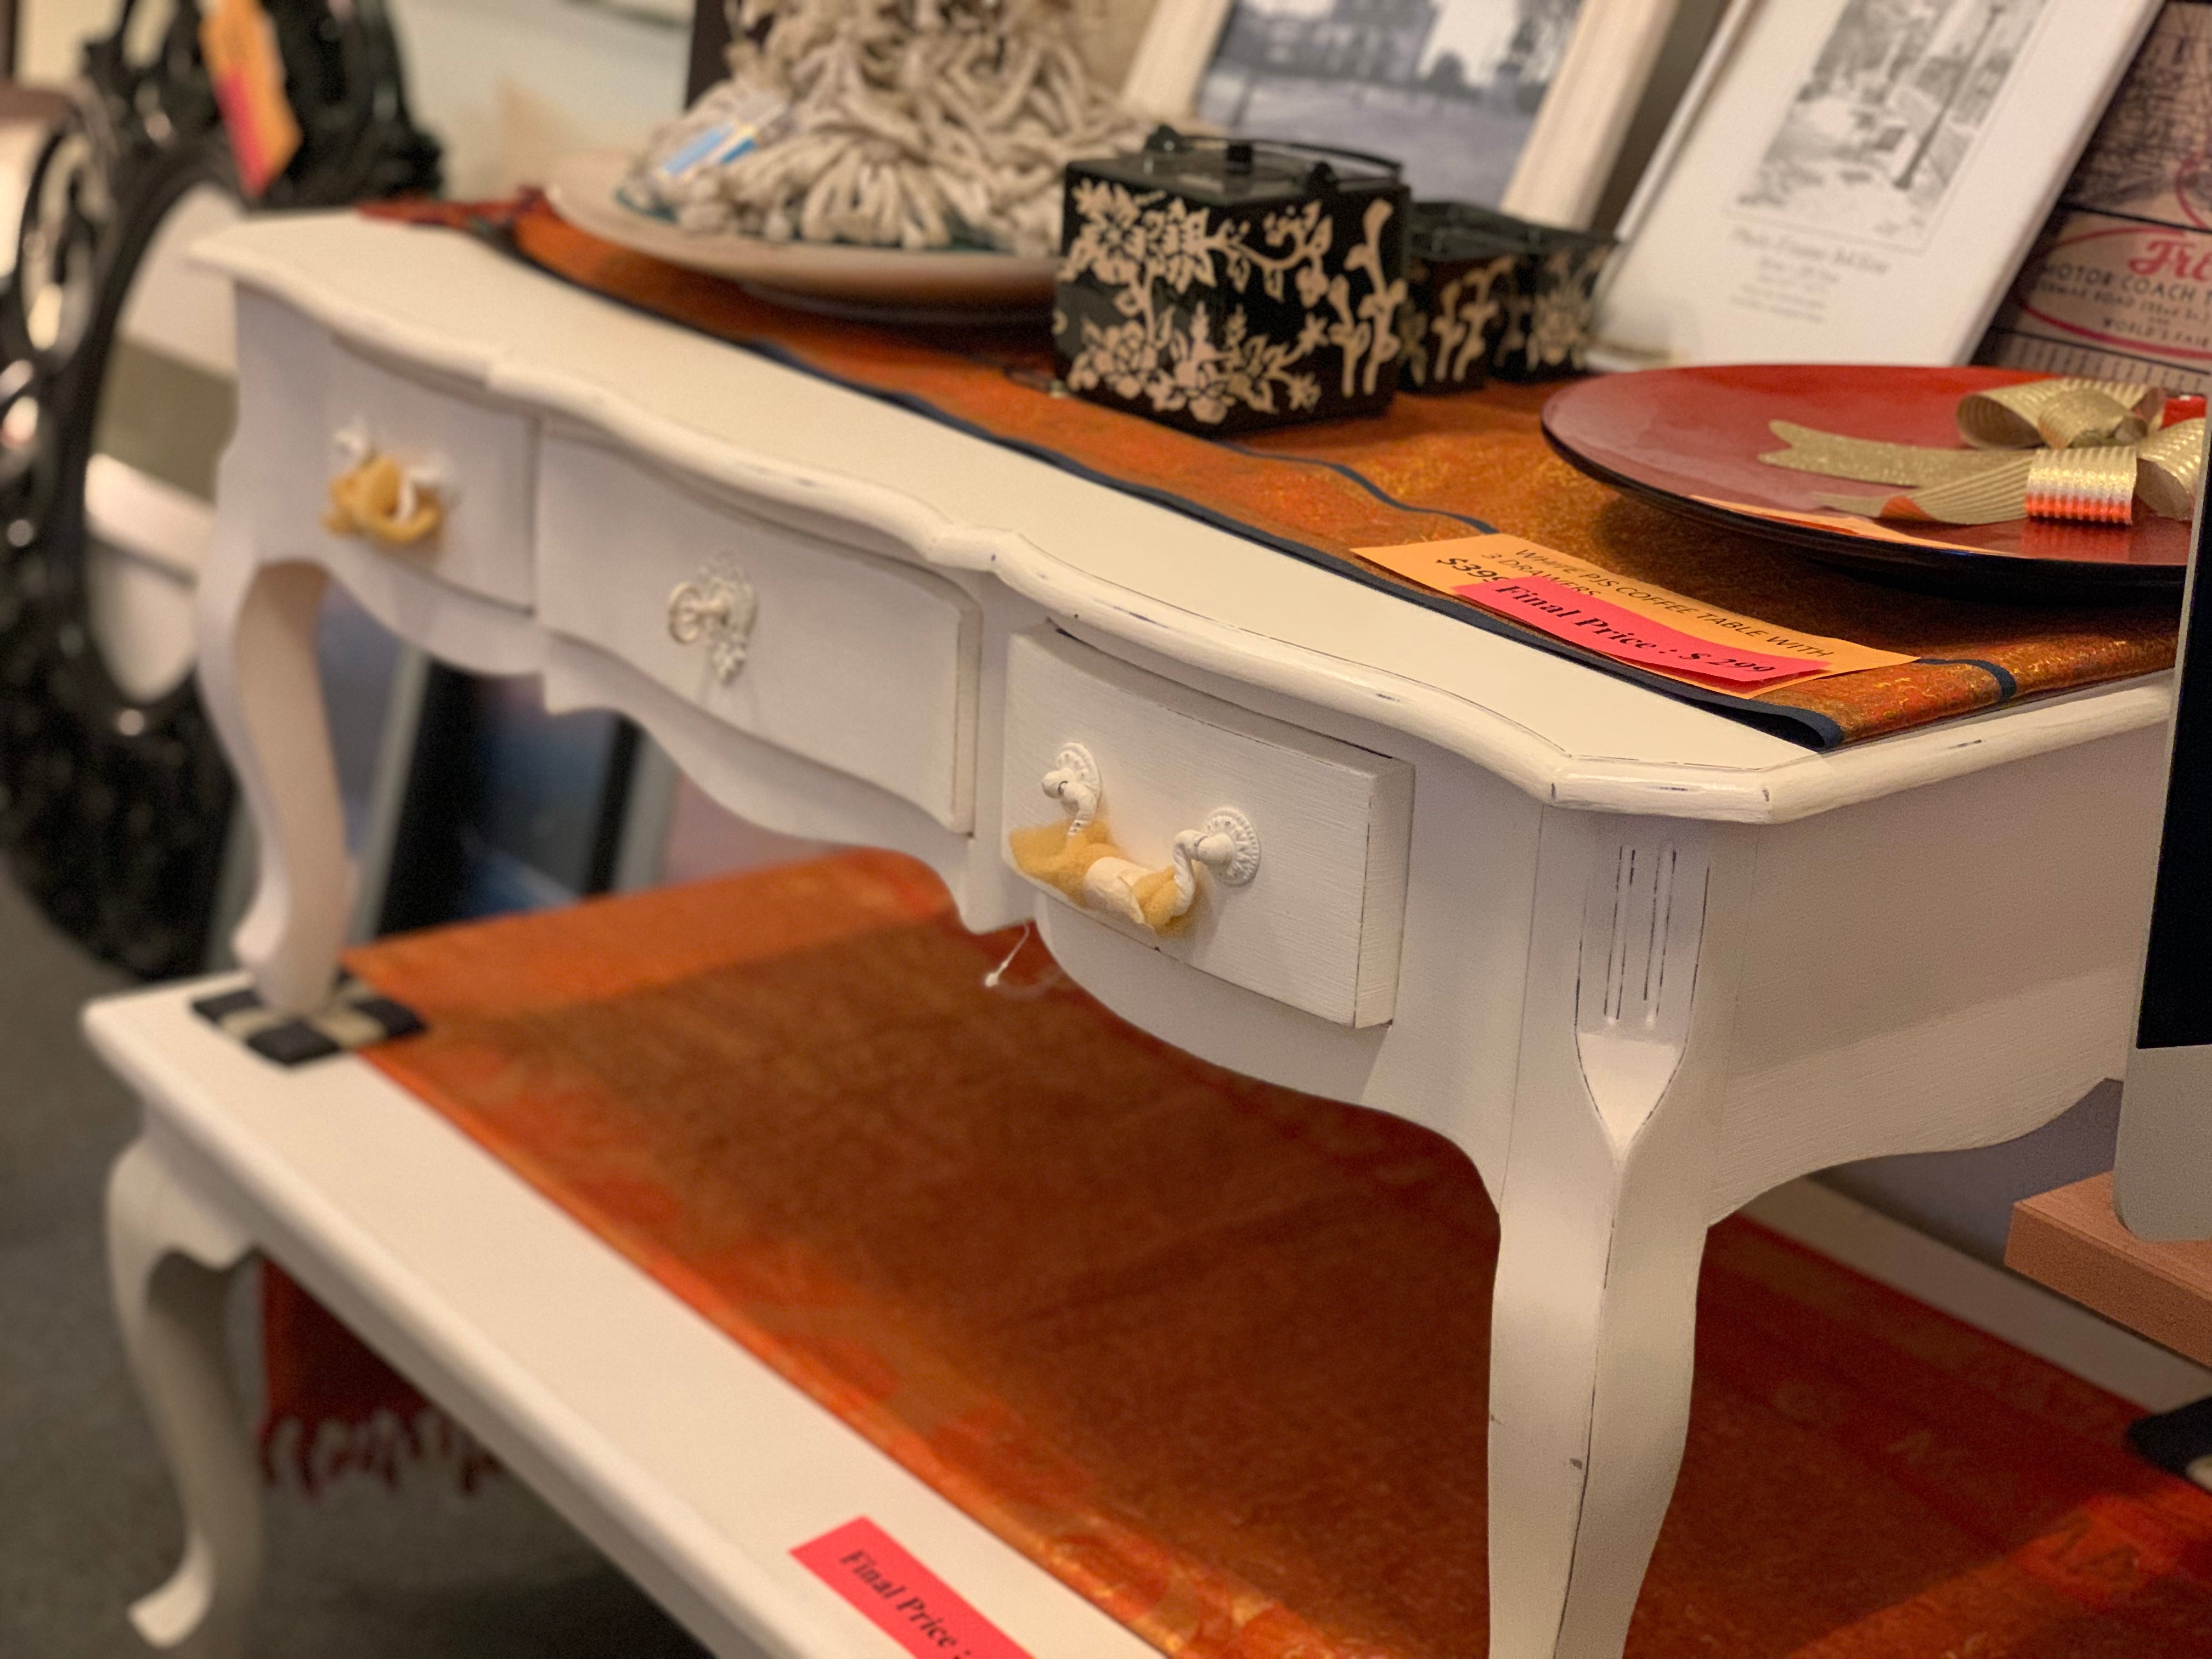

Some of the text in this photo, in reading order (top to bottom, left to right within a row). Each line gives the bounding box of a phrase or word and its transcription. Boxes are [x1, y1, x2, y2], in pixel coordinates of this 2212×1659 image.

[1495, 585, 1582, 618] Final
[1573, 617, 1656, 649] Price
[1516, 549, 1581, 574] WHITE
[1616, 586, 1699, 614] COFFEE
[1697, 612, 1768, 637] TABLE
[1767, 636, 1834, 657] WITH
[840, 1550, 906, 1598] Final
[896, 1598, 956, 1647] Price
